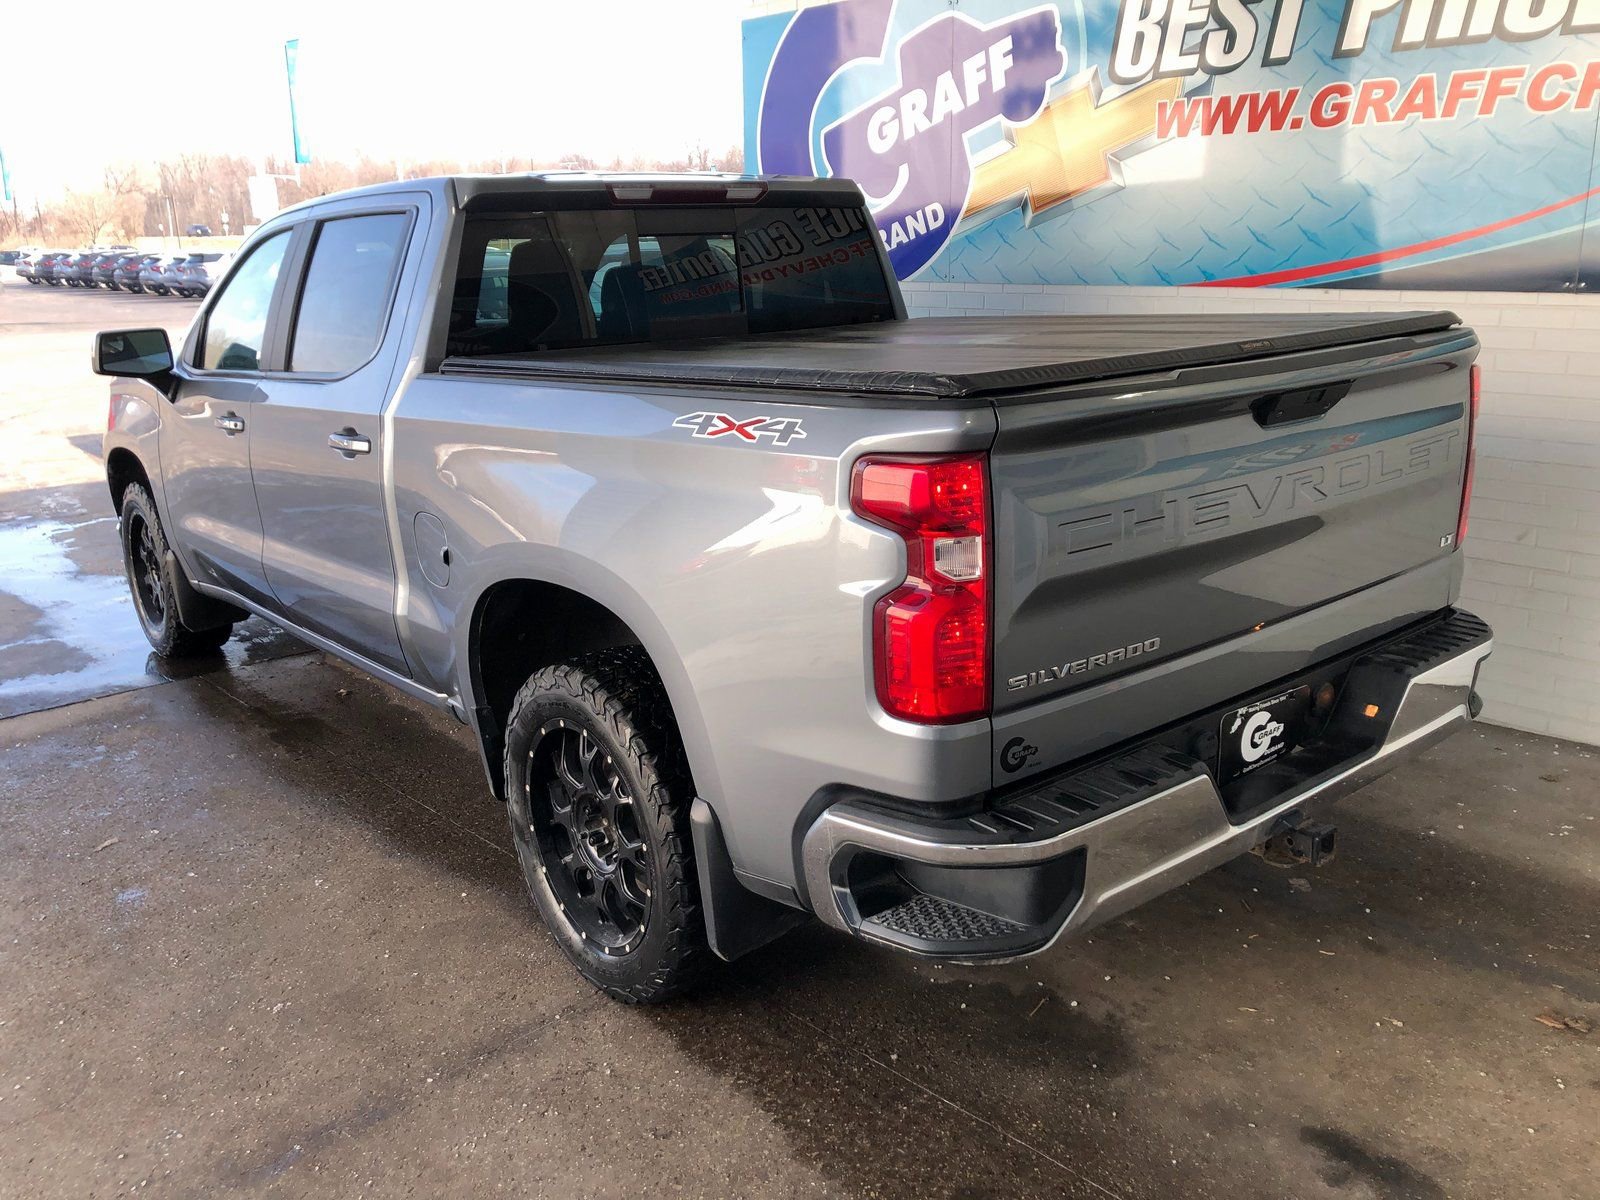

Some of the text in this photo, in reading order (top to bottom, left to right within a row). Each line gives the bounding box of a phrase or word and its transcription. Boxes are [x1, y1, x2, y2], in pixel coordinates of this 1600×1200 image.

[866, 34, 1015, 155] GRAFF
[1057, 428, 1460, 557] CHEVROLET
[1006, 636, 1162, 692] SILVERADO
[1257, 724, 1282, 741] GRAFF
